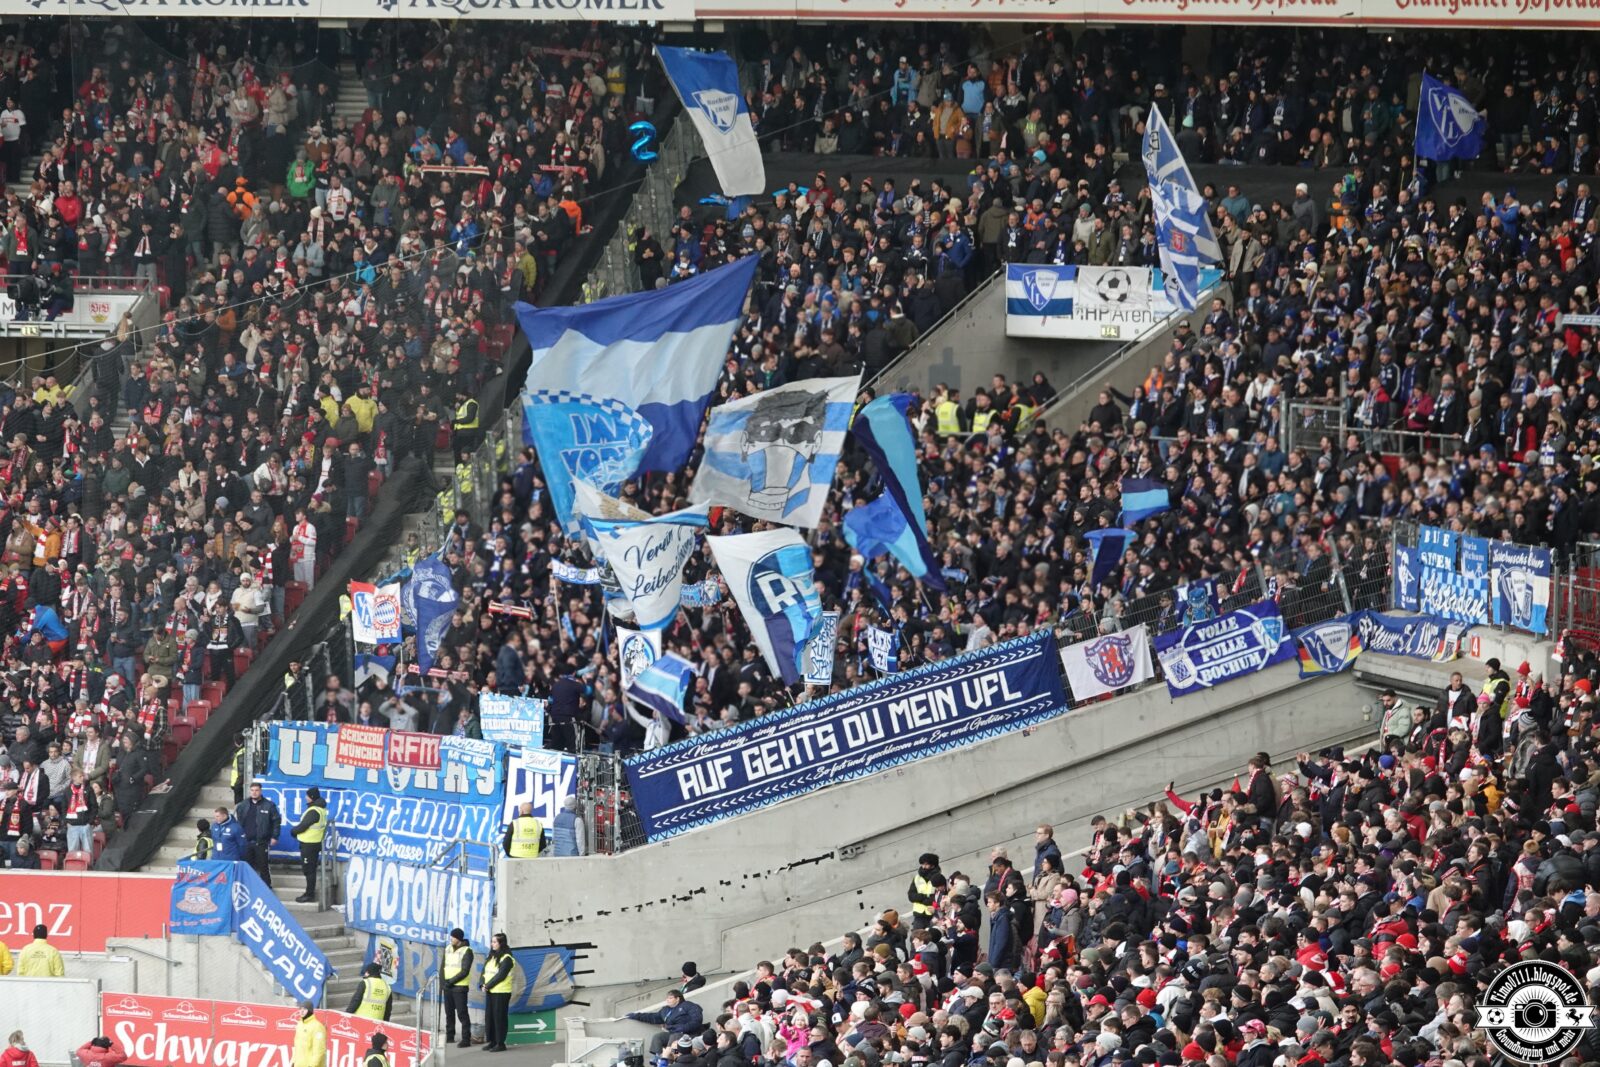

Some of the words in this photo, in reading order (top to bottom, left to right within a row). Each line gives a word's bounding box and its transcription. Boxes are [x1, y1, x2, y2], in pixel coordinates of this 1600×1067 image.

[624, 530, 674, 570] Verein
[1196, 616, 1239, 641] VOLLE
[1200, 636, 1247, 662] PULLE
[1472, 640, 1479, 653] 4
[1201, 652, 1262, 682] BOCHUM
[676, 755, 733, 800] AUF
[741, 723, 839, 781] GEHTS
[842, 707, 885, 748] DU
[888, 686, 958, 734] MEIN
[961, 670, 1022, 710] VFL
[689, 744, 718, 757] Nur
[752, 725, 776, 737] einig
[818, 707, 834, 718] wir
[950, 723, 969, 736] und
[339, 742, 383, 761] MÜNCHEN
[390, 734, 440, 765] RFM
[379, 834, 424, 859] Strasse
[346, 856, 492, 947] PHOTOMAFIA
[251, 897, 324, 981] ALARMSTUFE
[375, 922, 450, 944] BOCHU
[240, 917, 317, 999] BLAU
